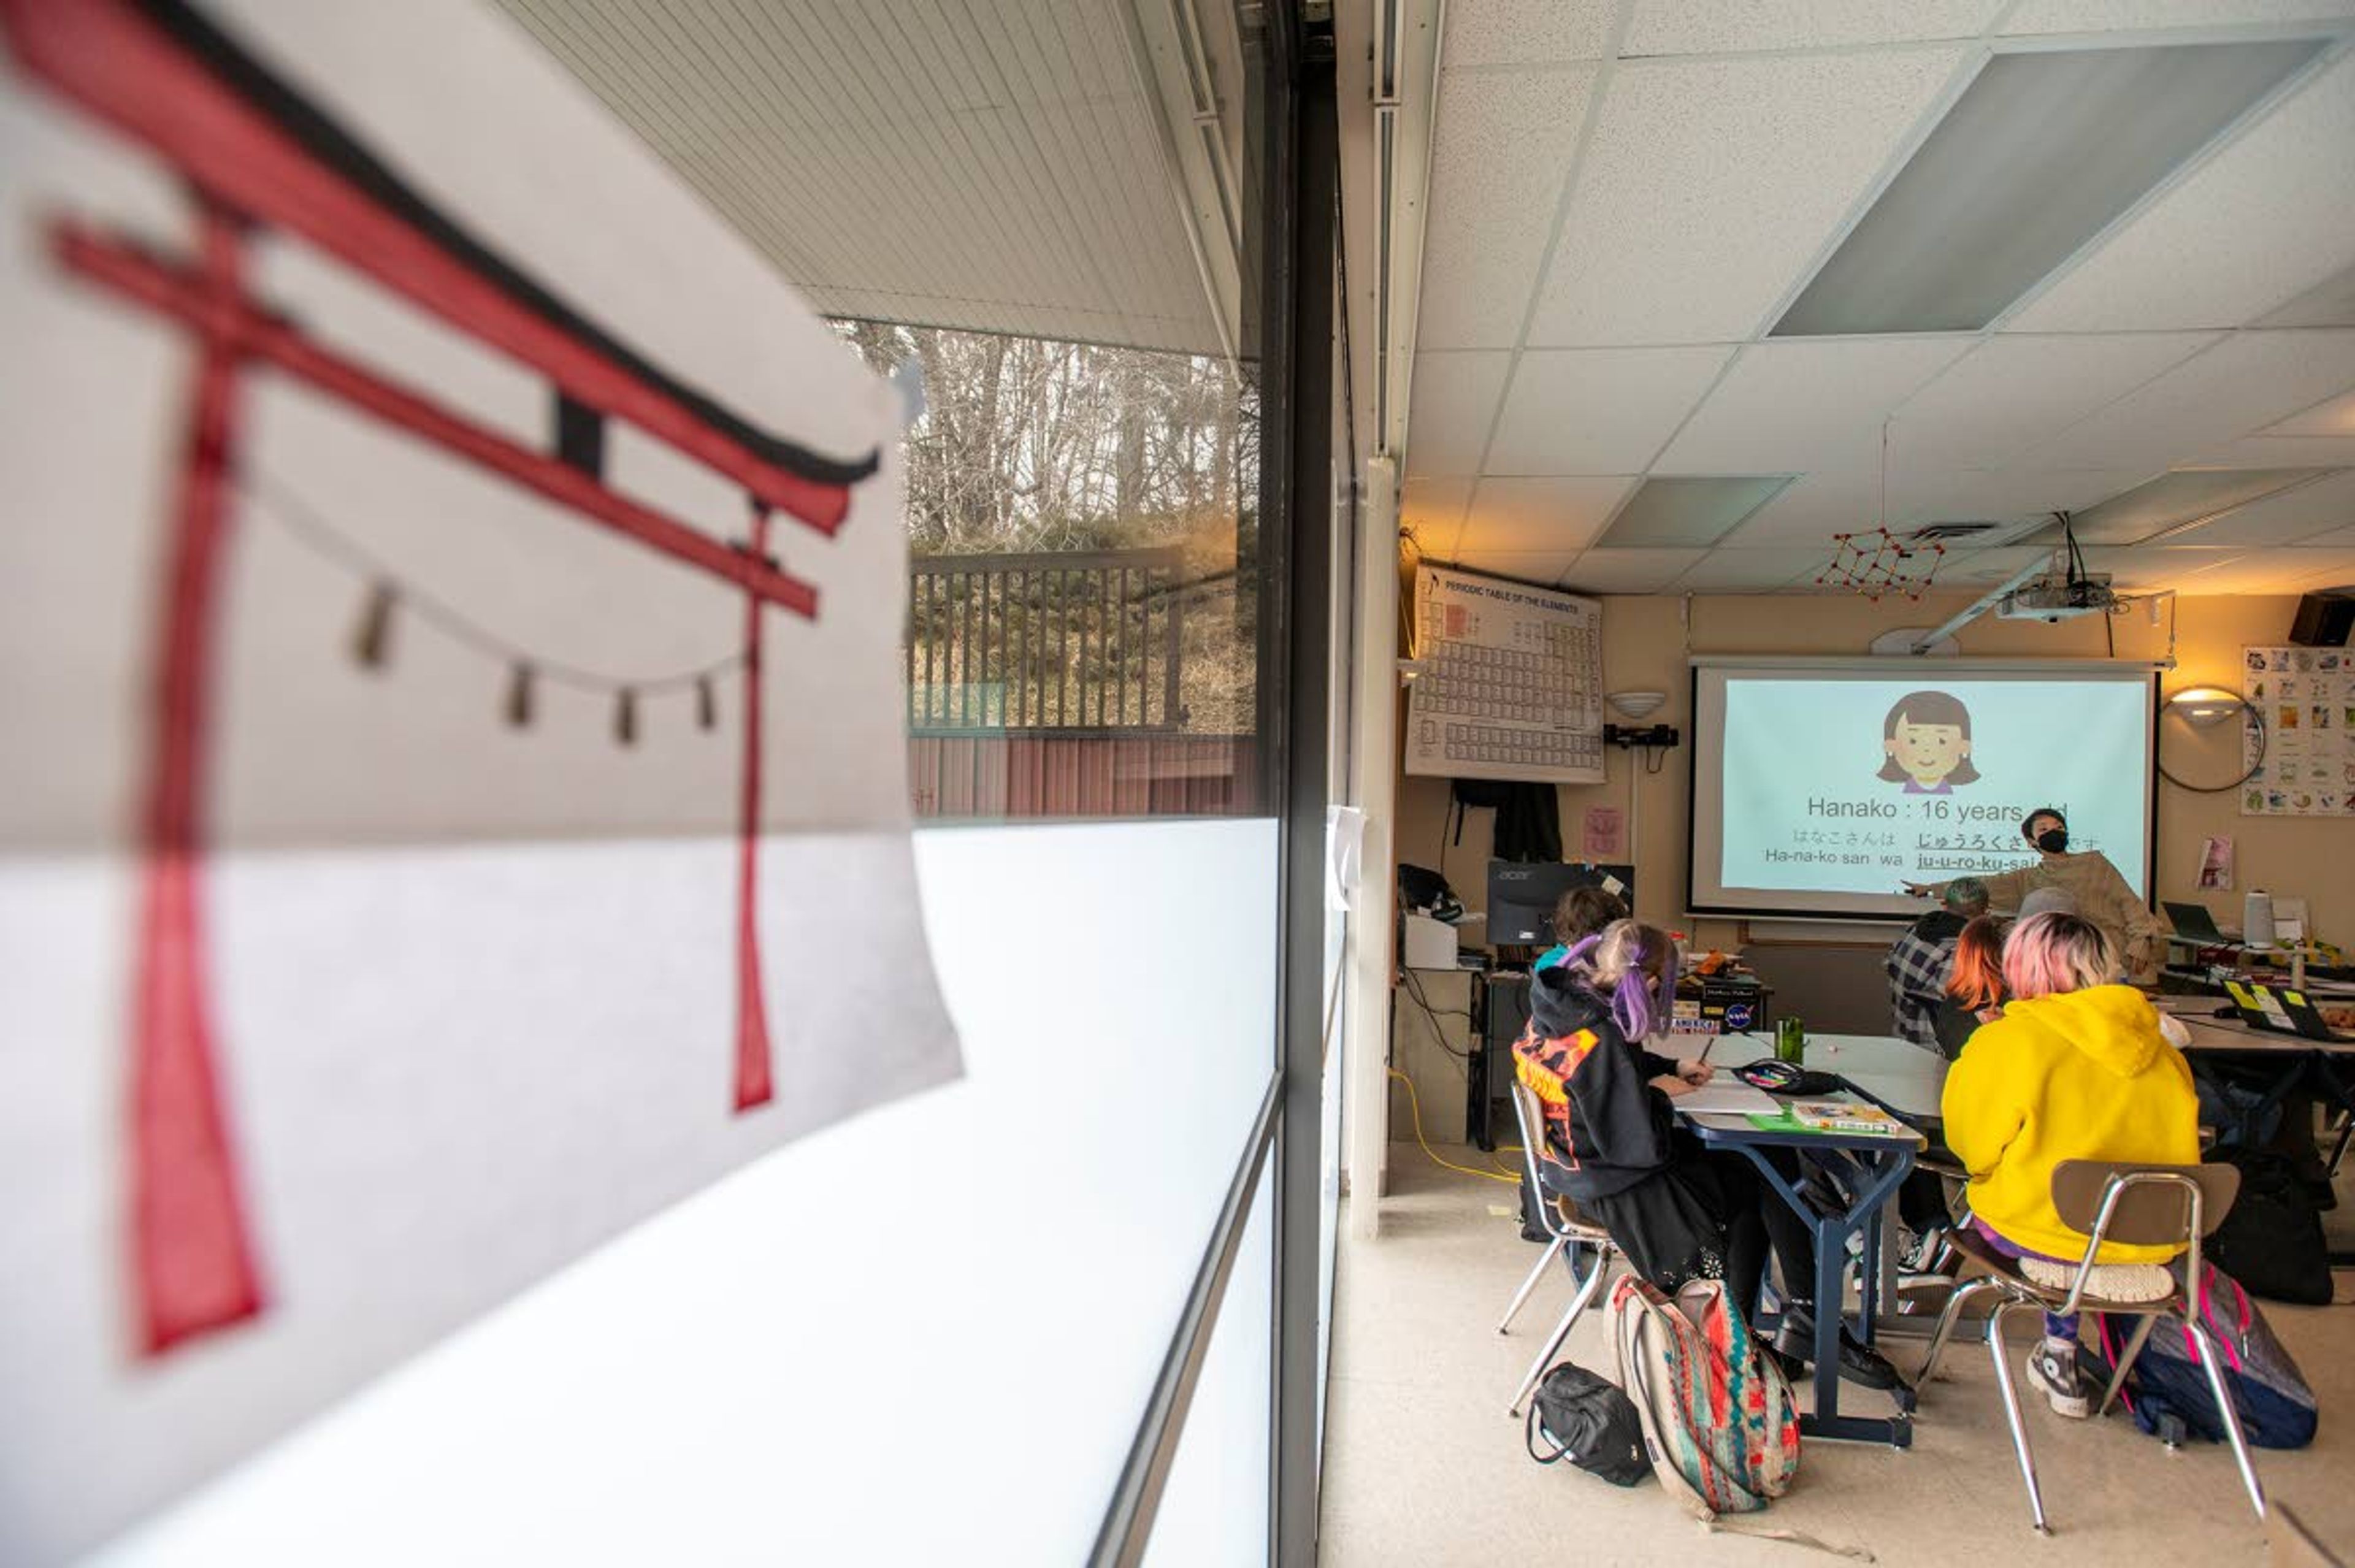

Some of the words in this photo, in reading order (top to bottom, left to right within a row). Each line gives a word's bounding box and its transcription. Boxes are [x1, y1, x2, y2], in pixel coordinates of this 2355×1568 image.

[1446, 581, 1483, 595] PERIODIC
[1485, 589, 1510, 601] TABLE
[1512, 594, 1524, 602] OF
[1525, 596, 1539, 606] THE
[1540, 600, 1579, 614] ELEMENTS
[1809, 797, 1897, 817] Hanako
[1922, 800, 1948, 819] 16
[1958, 805, 2023, 823] years
[1793, 830, 1896, 846] はなこさんは
[1766, 848, 1837, 864] Ha-na-ko
[1842, 853, 1869, 865] san
[1880, 854, 1902, 866] wa
